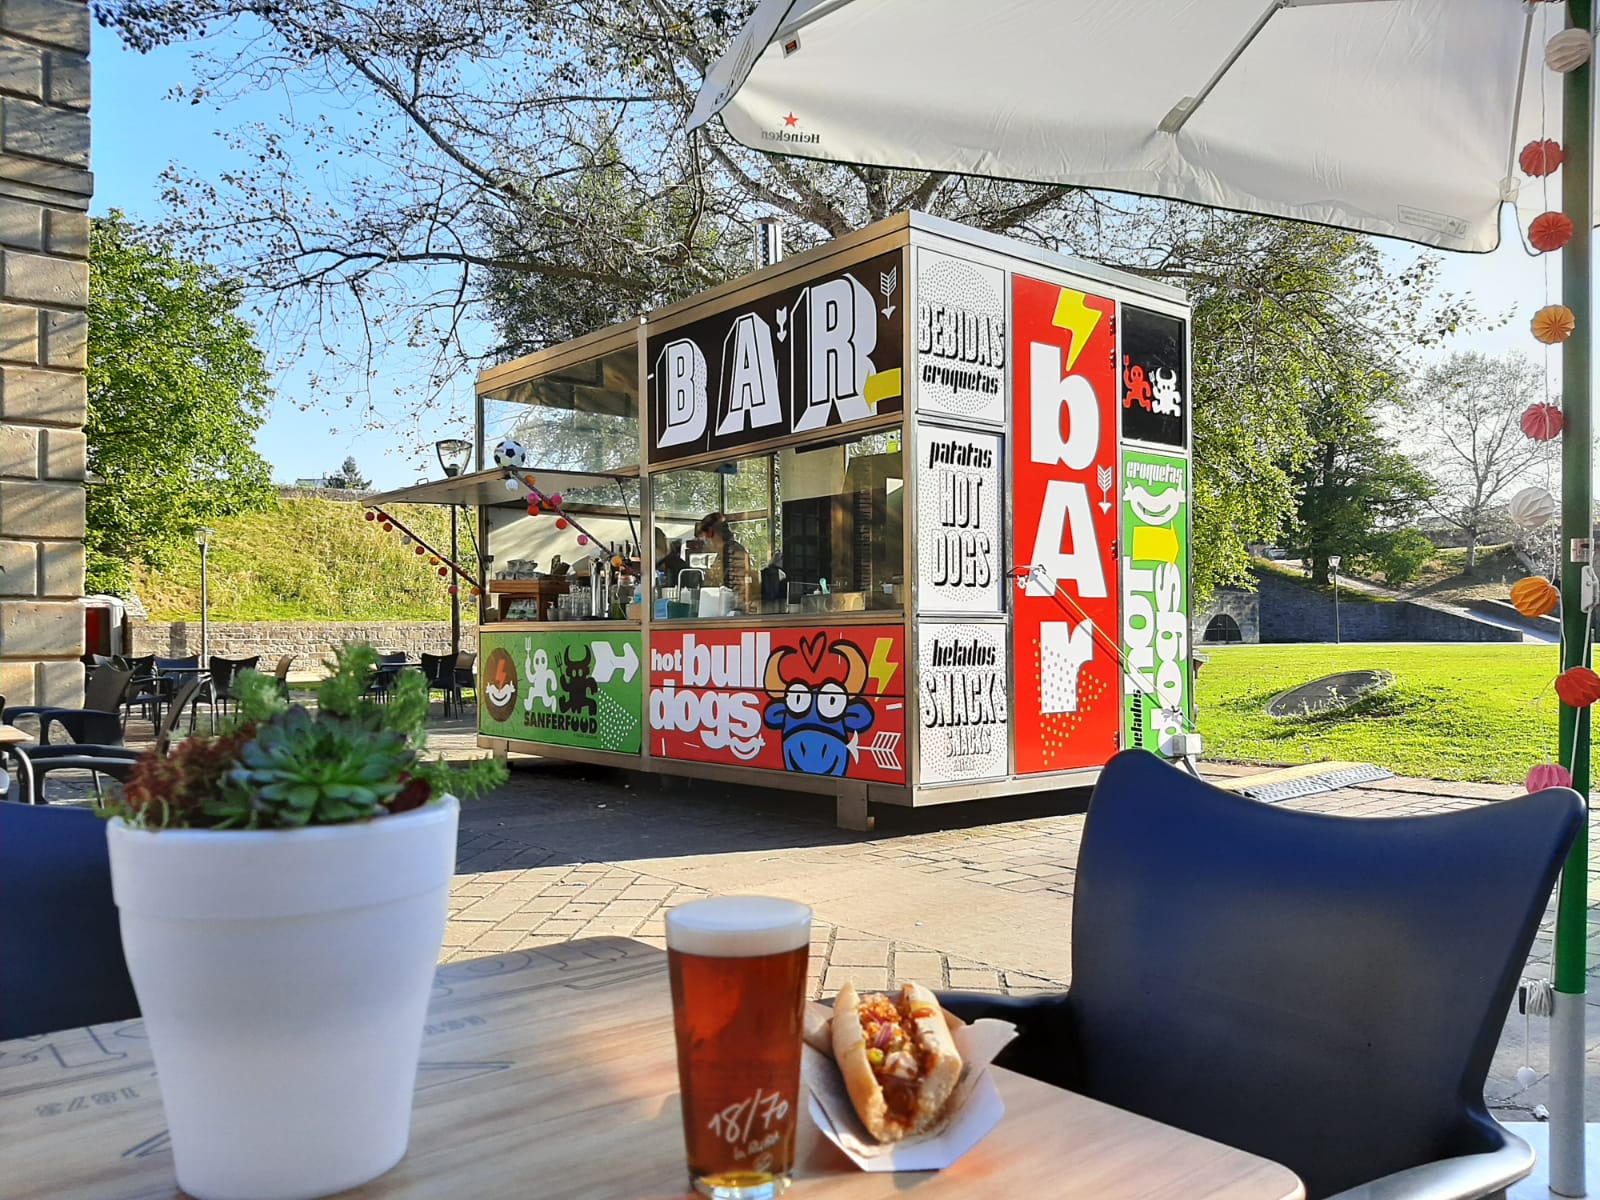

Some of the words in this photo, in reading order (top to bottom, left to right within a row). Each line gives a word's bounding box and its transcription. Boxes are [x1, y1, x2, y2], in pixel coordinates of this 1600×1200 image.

[655, 273, 878, 449] BAR
[918, 302, 1005, 369] BEBIDAS
[922, 363, 999, 395] croquetas
[929, 440, 993, 469] patatas
[1126, 461, 1184, 484] croquetas
[938, 470, 983, 529] HOT
[930, 530, 991, 588] DOGS
[650, 649, 682, 672] hot
[683, 632, 771, 688] bull
[932, 639, 996, 667] helados
[524, 711, 598, 734] SANFERFOOD
[649, 680, 762, 750] dogs
[920, 670, 1008, 728] SNACKS
[945, 727, 992, 758] SNACKS
[708, 1088, 789, 1143] 18/70
